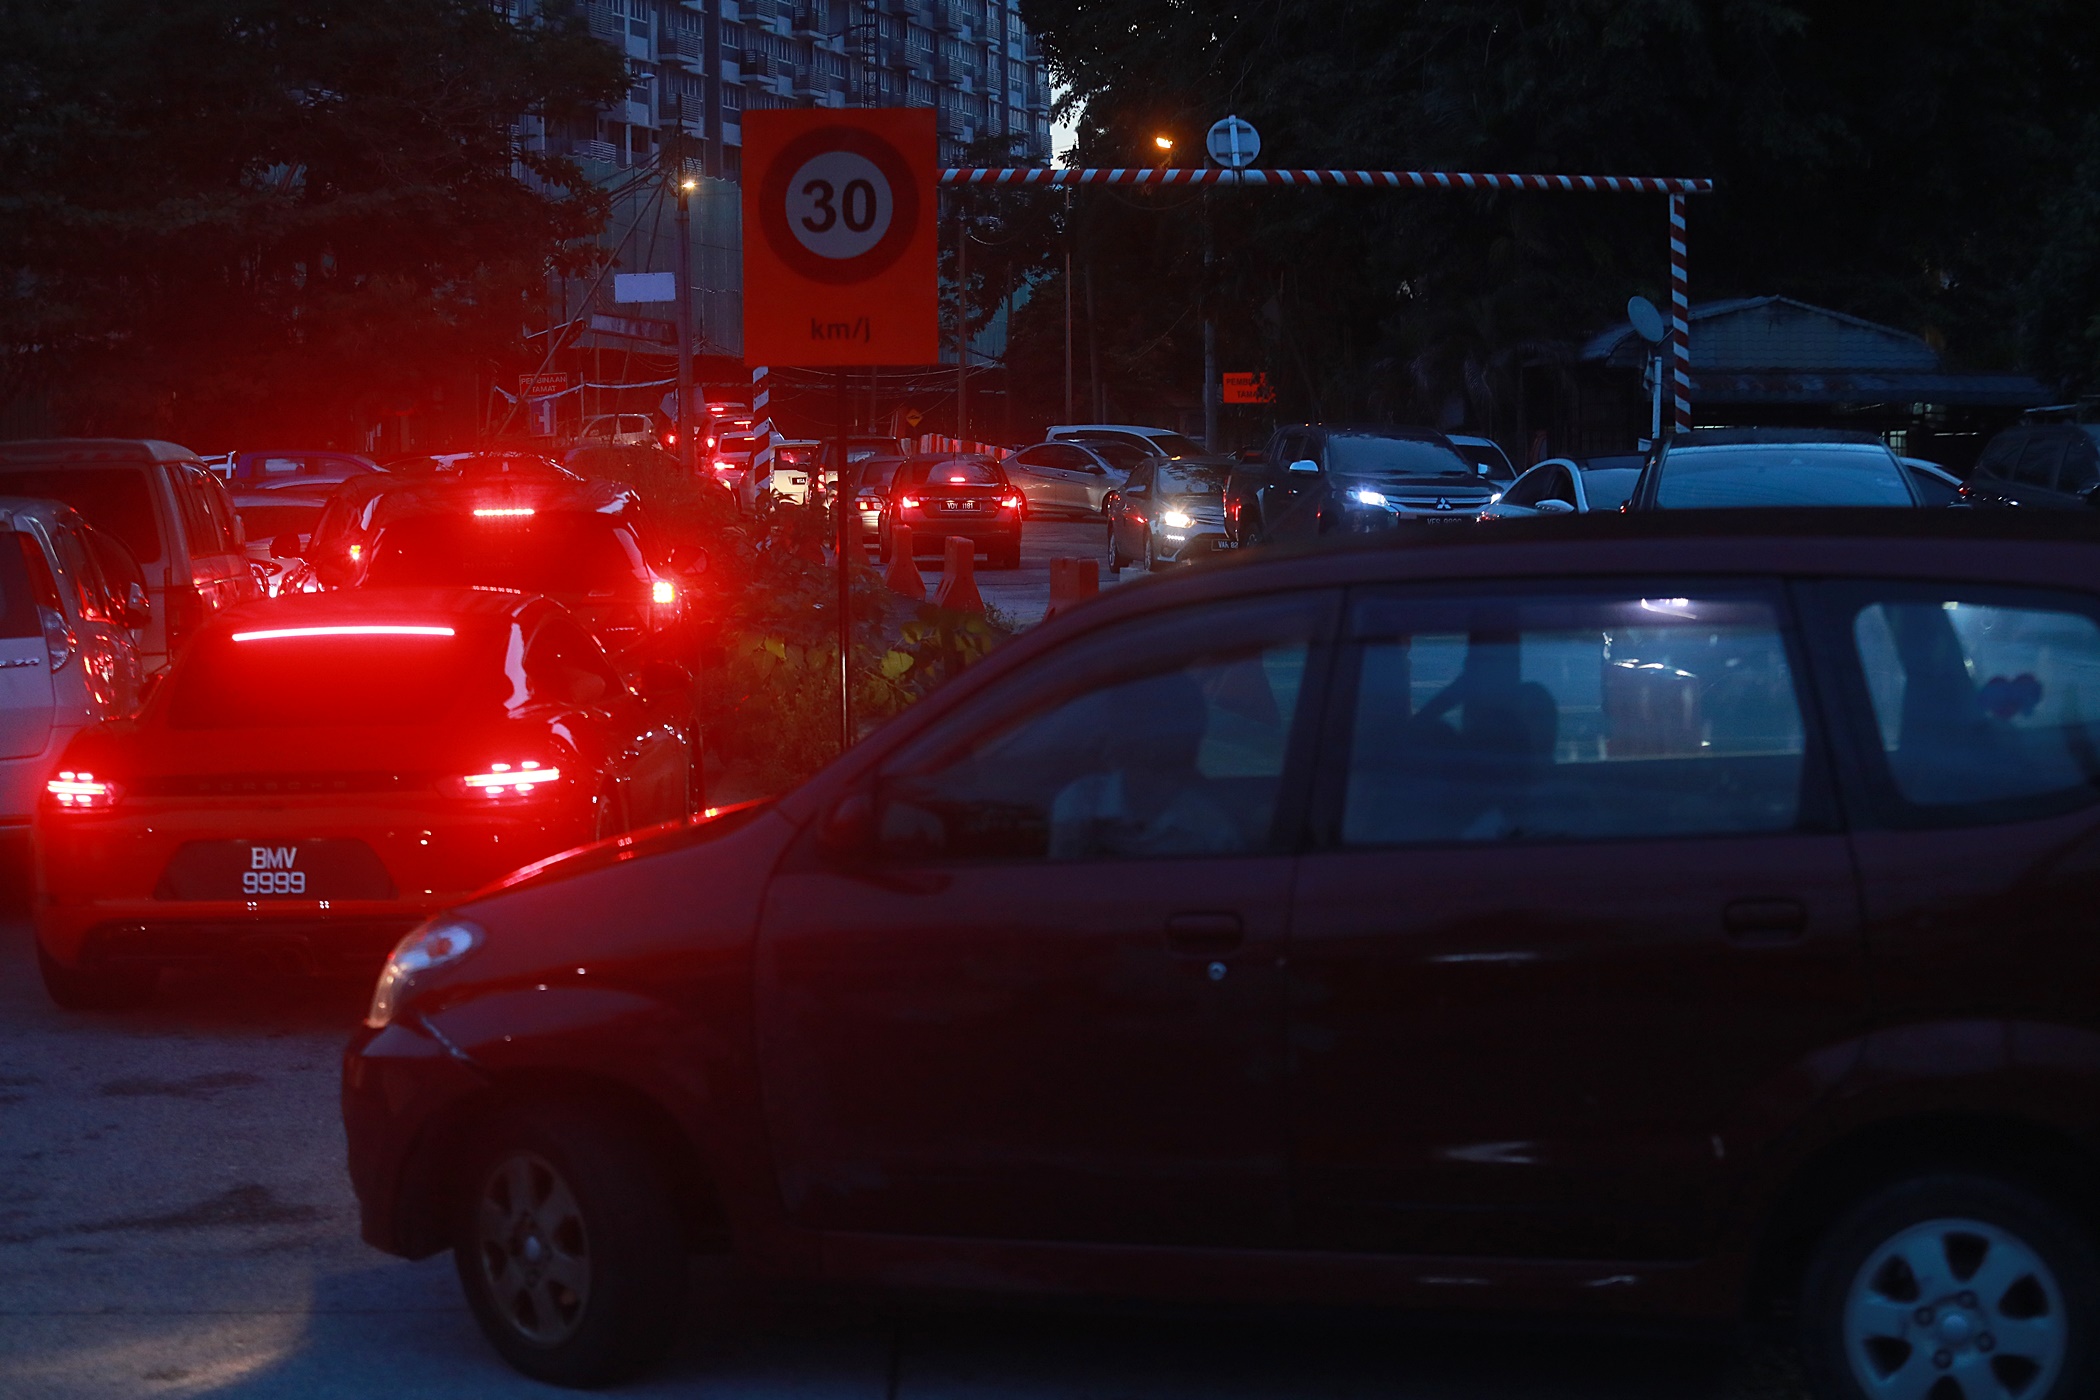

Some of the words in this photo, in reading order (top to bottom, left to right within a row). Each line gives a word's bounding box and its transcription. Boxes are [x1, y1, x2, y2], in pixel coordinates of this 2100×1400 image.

[801, 178, 876, 234] 30
[810, 317, 871, 343] km/j
[251, 846, 298, 870] BMV
[241, 871, 306, 895] 9999
